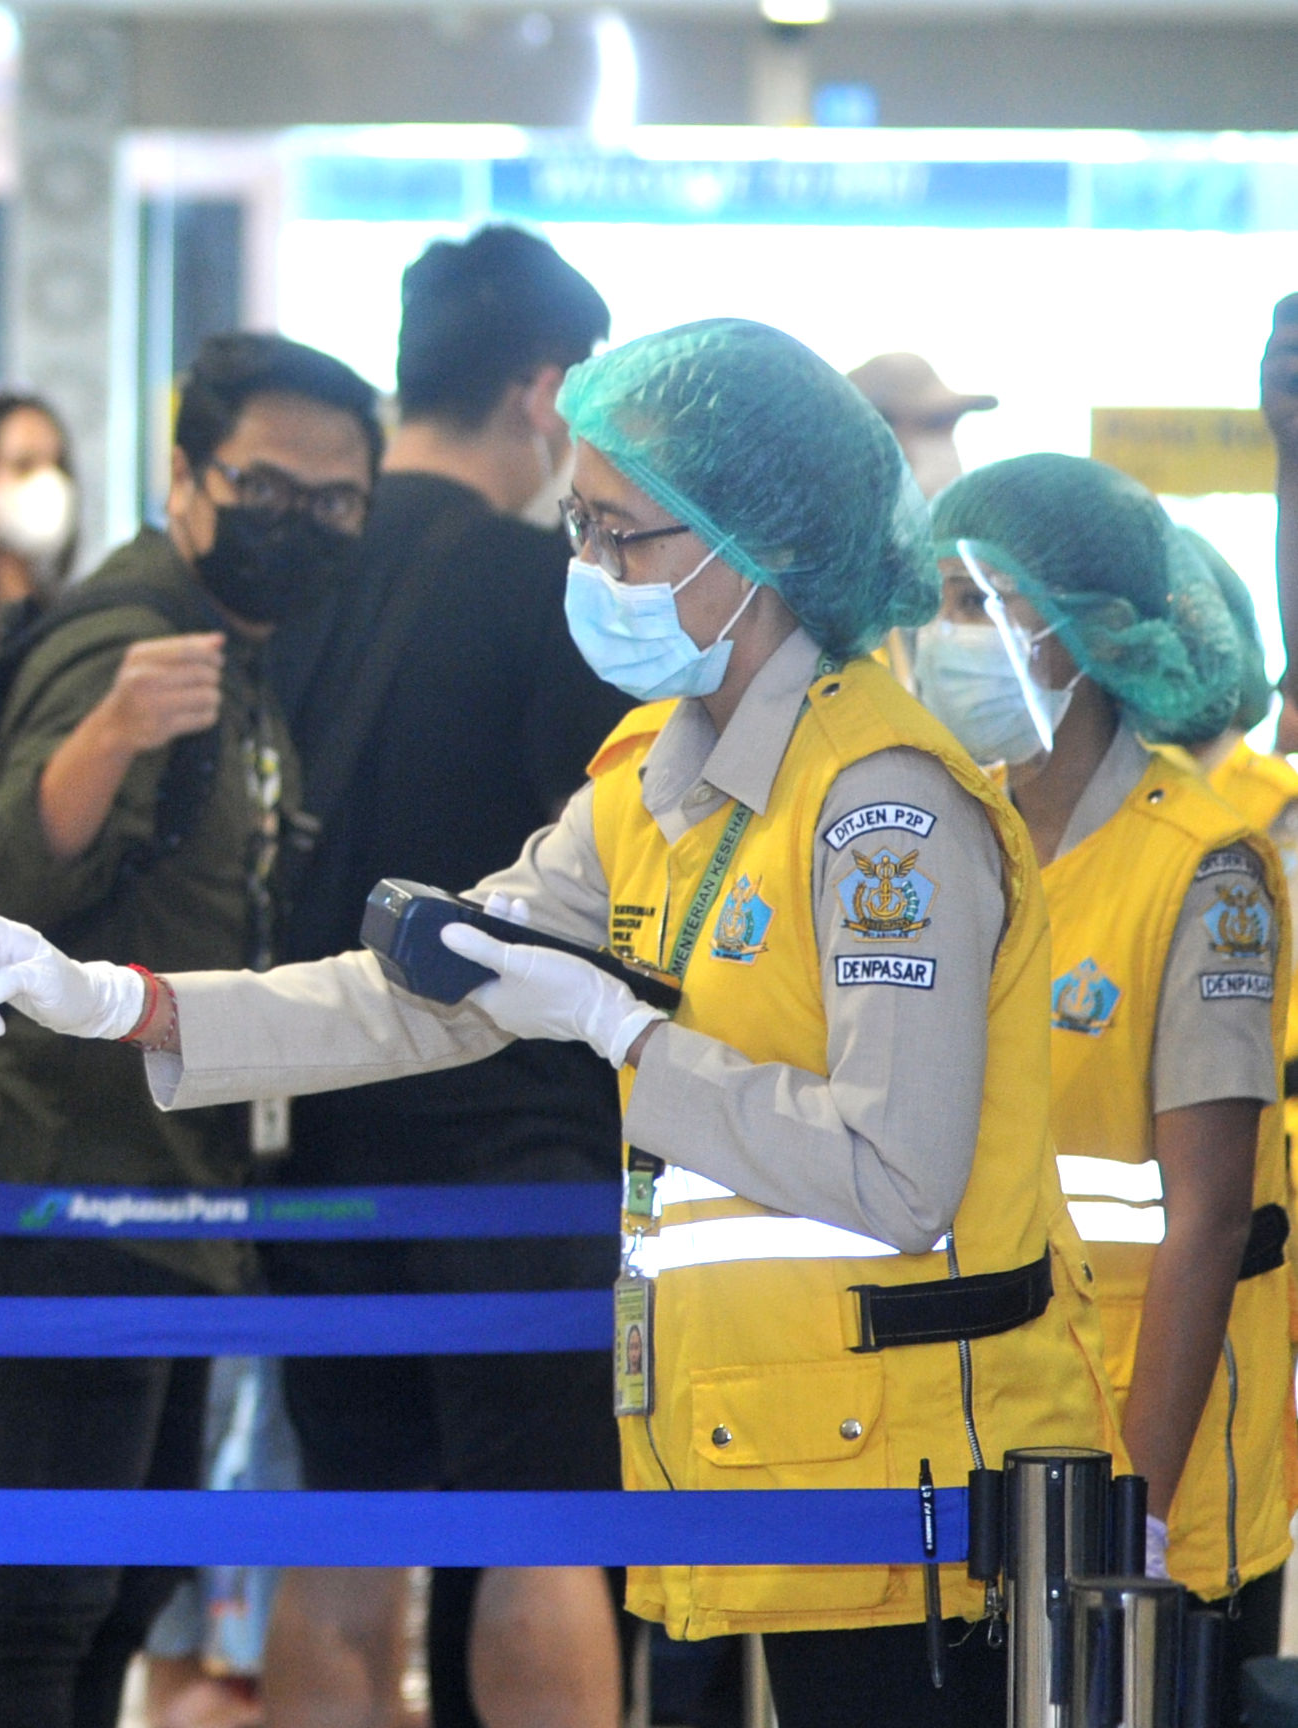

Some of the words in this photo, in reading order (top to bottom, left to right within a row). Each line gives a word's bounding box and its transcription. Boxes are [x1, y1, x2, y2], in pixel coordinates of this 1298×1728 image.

[835, 808, 887, 842] DITJEN
[895, 809, 924, 828] P2P
[843, 960, 927, 983] DENPASAR
